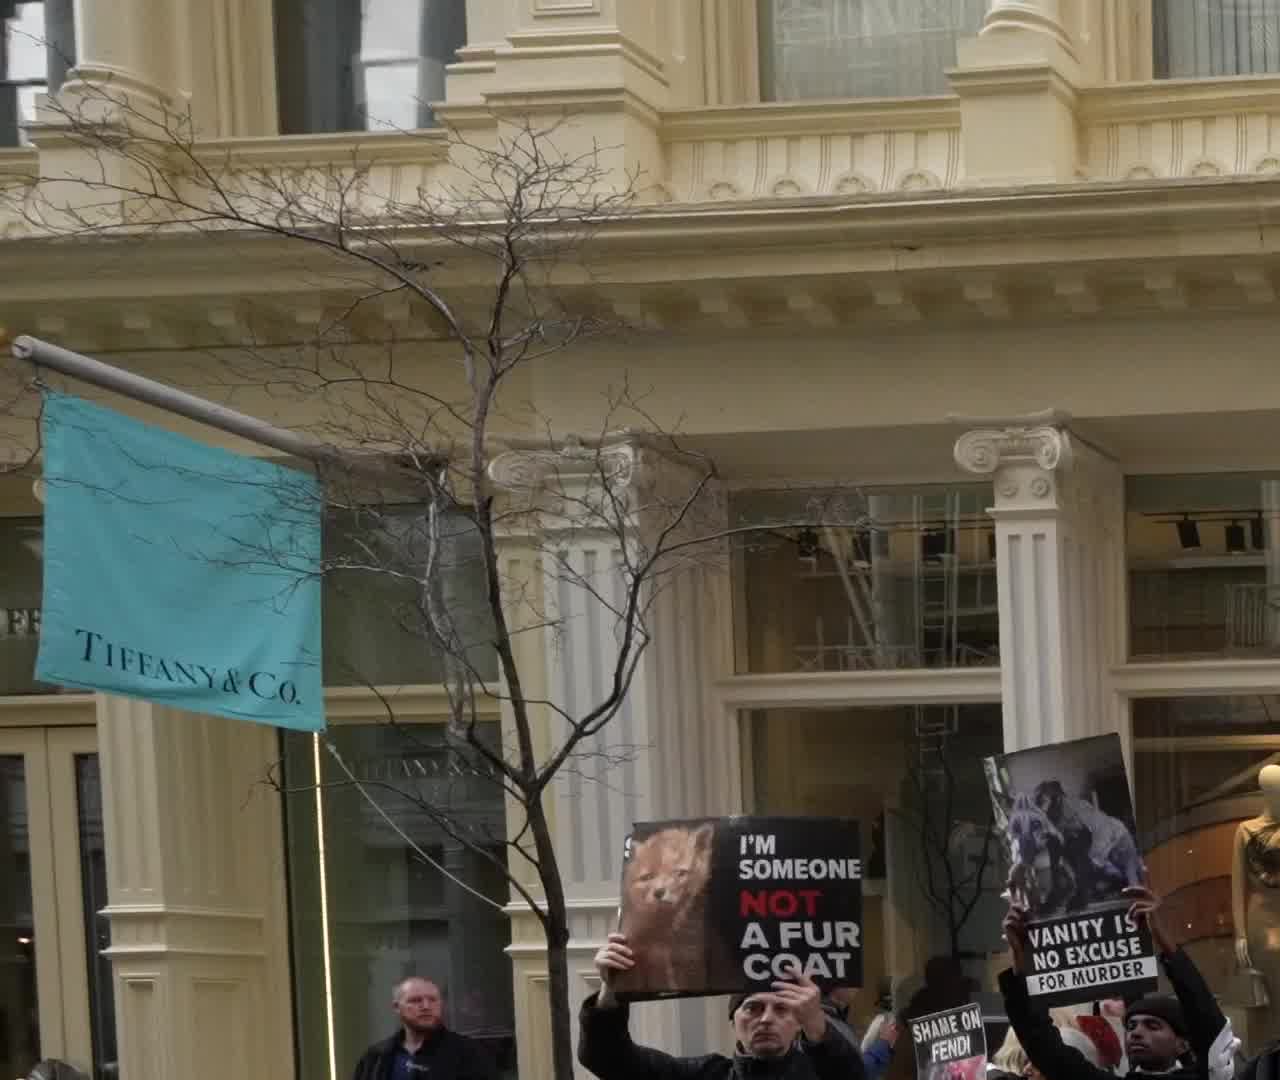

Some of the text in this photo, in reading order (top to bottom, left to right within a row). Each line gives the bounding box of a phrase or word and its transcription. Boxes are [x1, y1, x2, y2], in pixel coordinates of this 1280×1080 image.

[75, 628, 218, 689] TIFFANY
[222, 667, 242, 695] &
[739, 834, 776, 855] I'M
[738, 859, 862, 880] SOMEONE
[740, 889, 824, 918] NOT
[740, 921, 861, 949] A FUR
[1028, 914, 1139, 949] VANITY IS
[743, 952, 851, 981] COAT
[1032, 937, 1142, 971] NO EXCUSE
[1038, 961, 1145, 992] FOR MURDER
[912, 1009, 982, 1043] SHAME ON
[931, 1035, 971, 1063] FENDI
